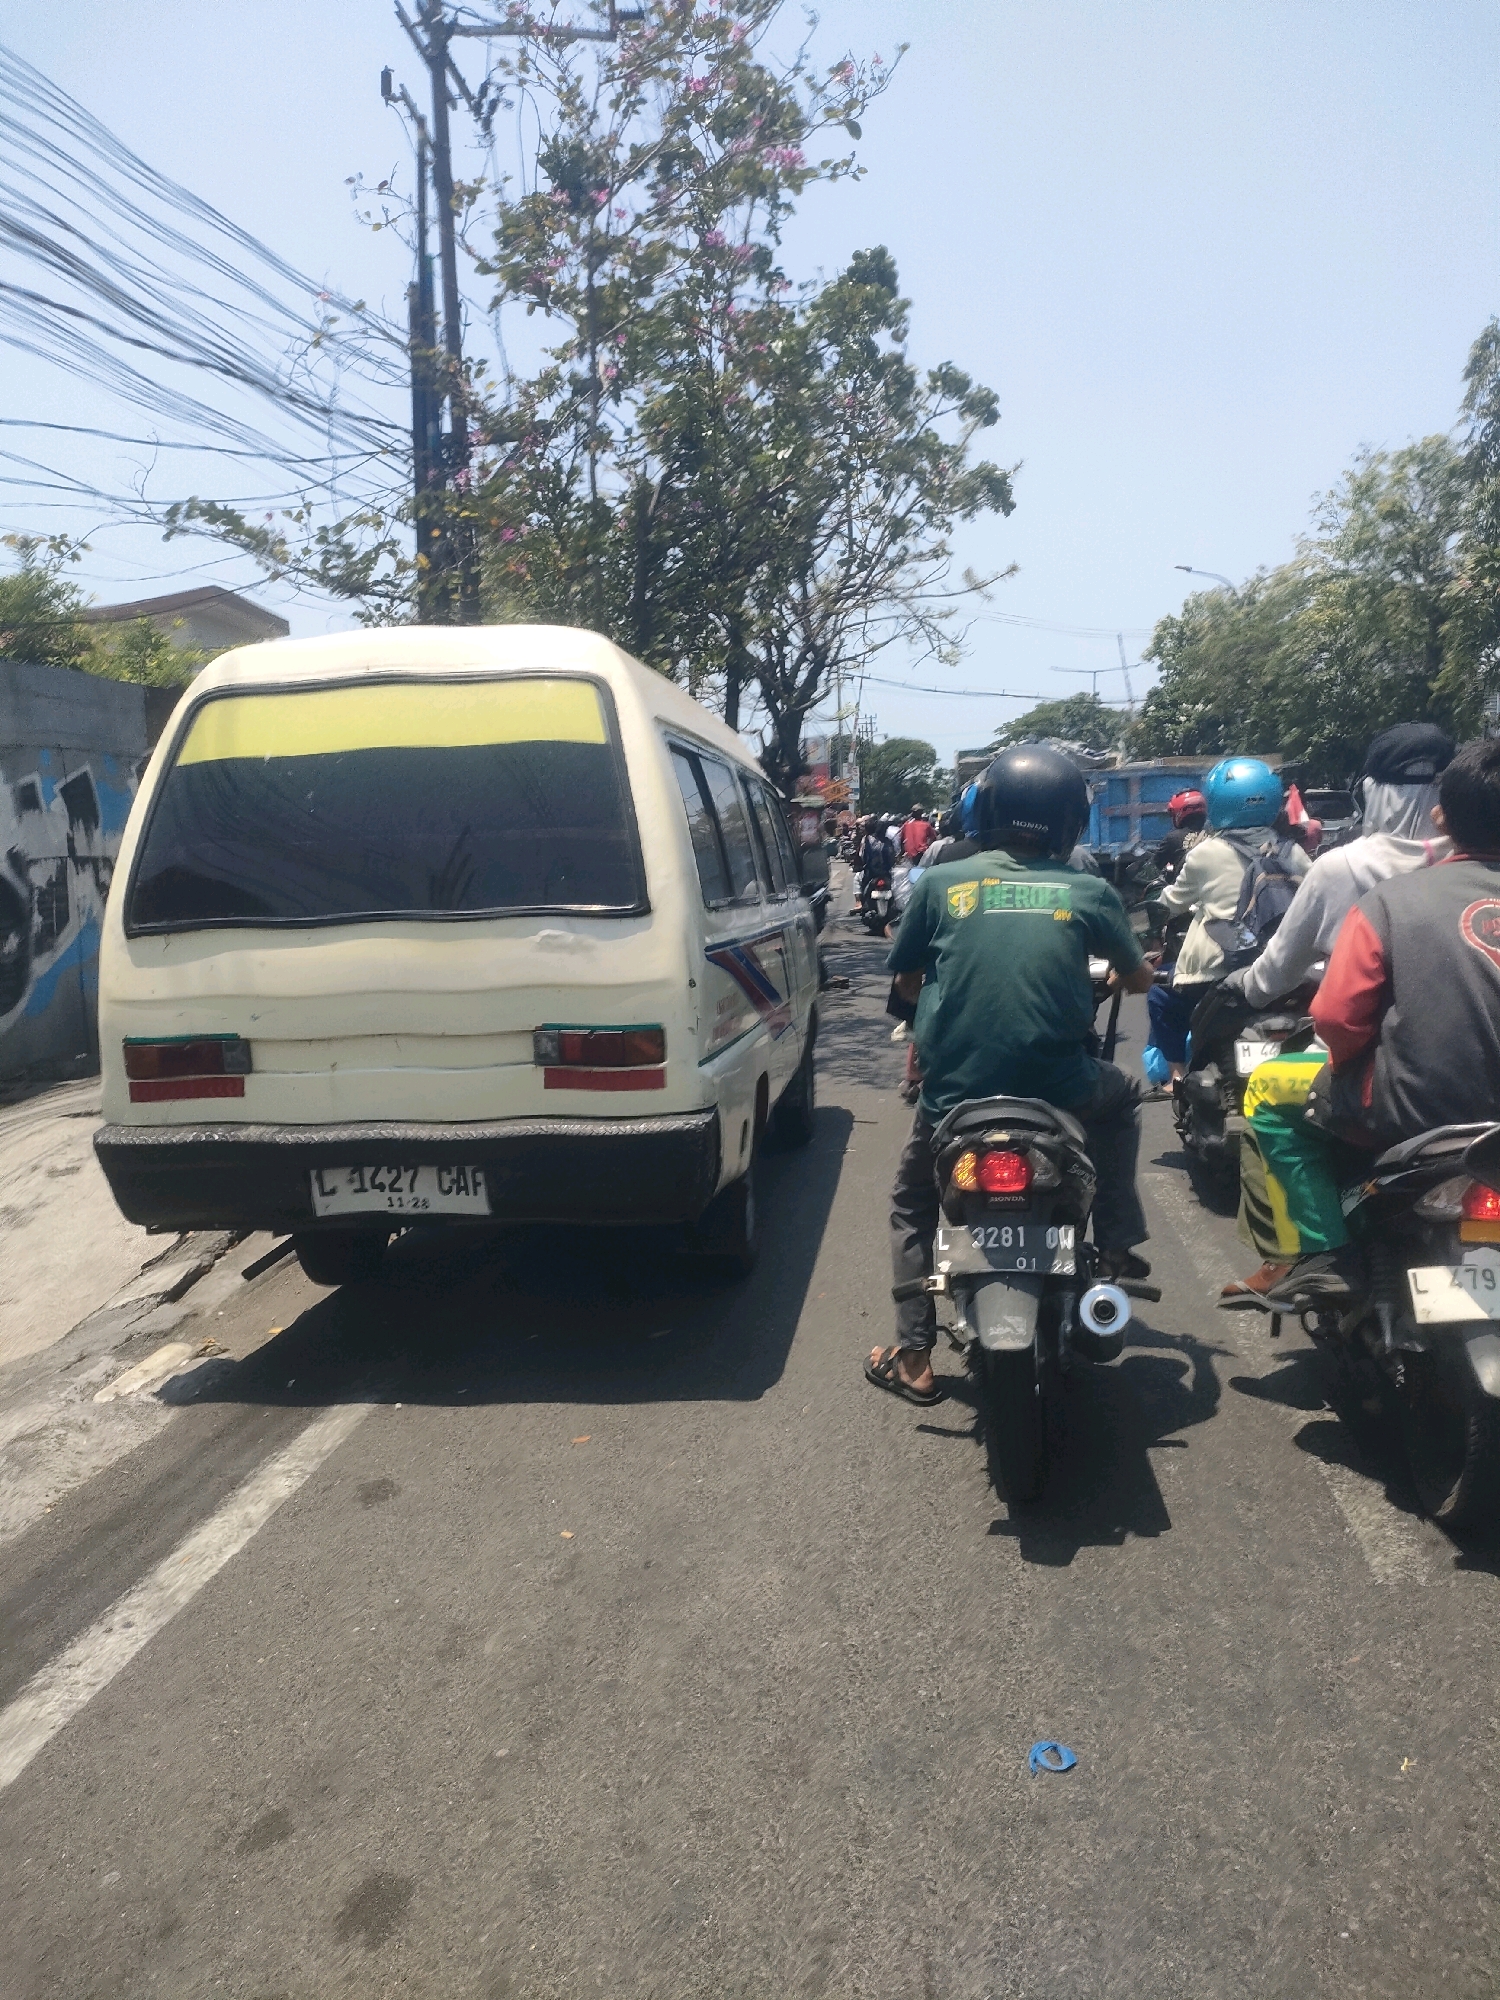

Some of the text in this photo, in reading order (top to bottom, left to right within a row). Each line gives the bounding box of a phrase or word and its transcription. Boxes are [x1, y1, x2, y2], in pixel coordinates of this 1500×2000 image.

[1012, 819, 1049, 832] HONDA
[315, 1169, 337, 1197] L
[351, 1166, 419, 1193] 1427
[989, 1195, 1026, 1203] HONDA
[937, 1229, 950, 1251] L
[971, 1225, 1026, 1250] 3281
[1412, 1267, 1496, 1294] L 479
